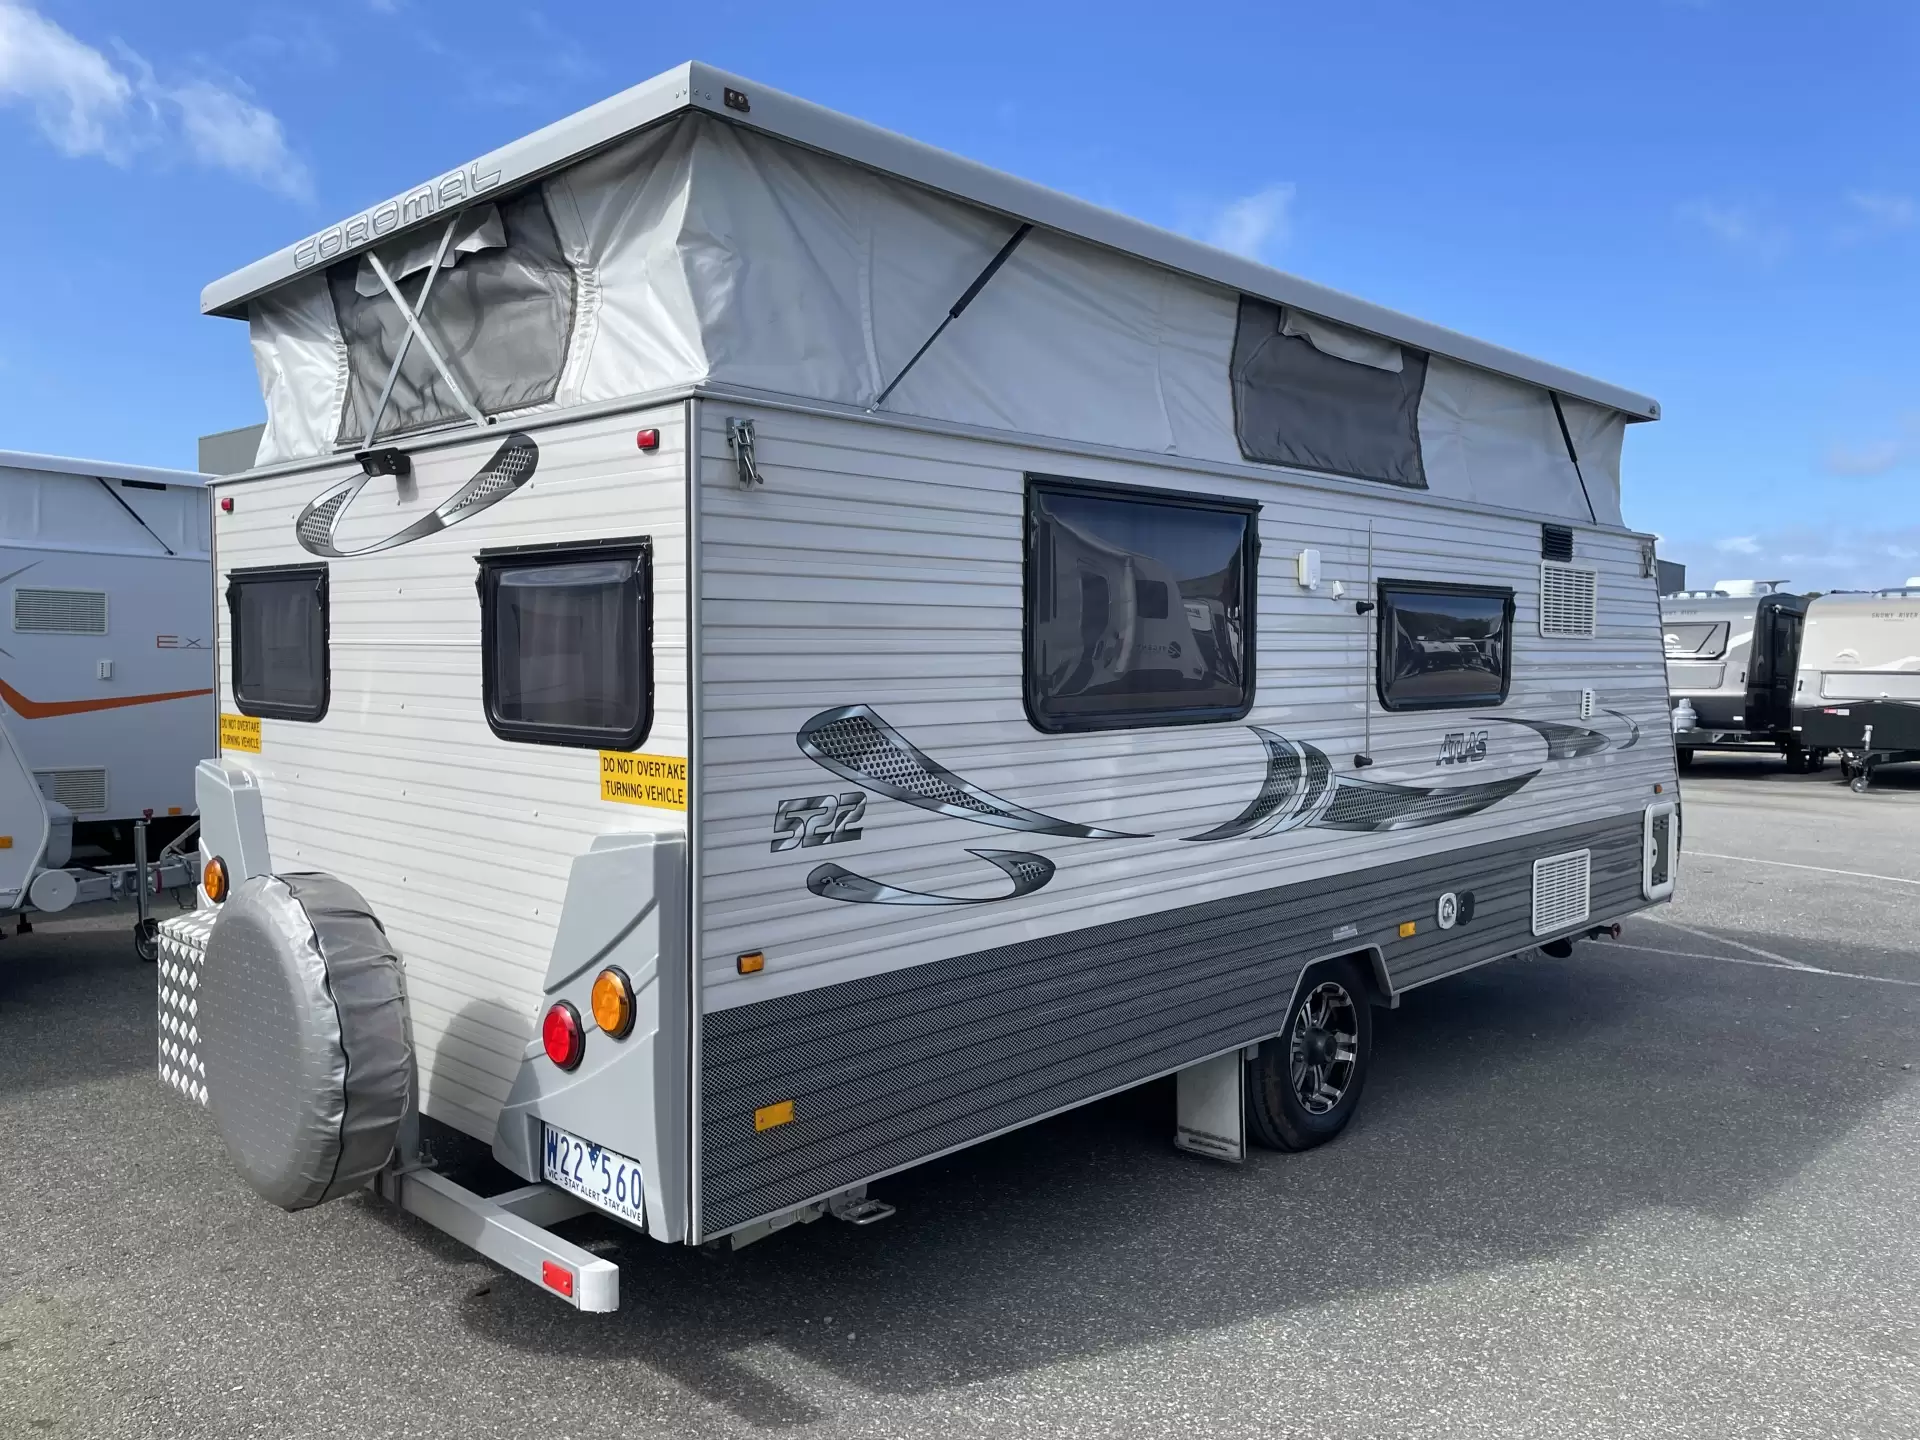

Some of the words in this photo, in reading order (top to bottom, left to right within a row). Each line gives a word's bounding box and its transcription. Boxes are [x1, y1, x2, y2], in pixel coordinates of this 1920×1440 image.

[293, 162, 502, 270] COROMAL
[157, 635, 213, 650] Ex
[602, 757, 615, 773] DO
[617, 758, 634, 775] NOT
[637, 760, 686, 780] OVERTAKE
[1436, 730, 1489, 766] ATLAS
[605, 780, 643, 799] TURNING
[645, 785, 684, 804] VEHICLE
[770, 791, 867, 853] 522
[546, 1127, 583, 1183] W22
[601, 1153, 641, 1210] 560
[547, 1167, 558, 1181] VIC
[564, 1177, 580, 1191] STAY
[580, 1186, 601, 1202] ALERT
[603, 1196, 621, 1213] STAY
[621, 1204, 641, 1222] ALIVE
